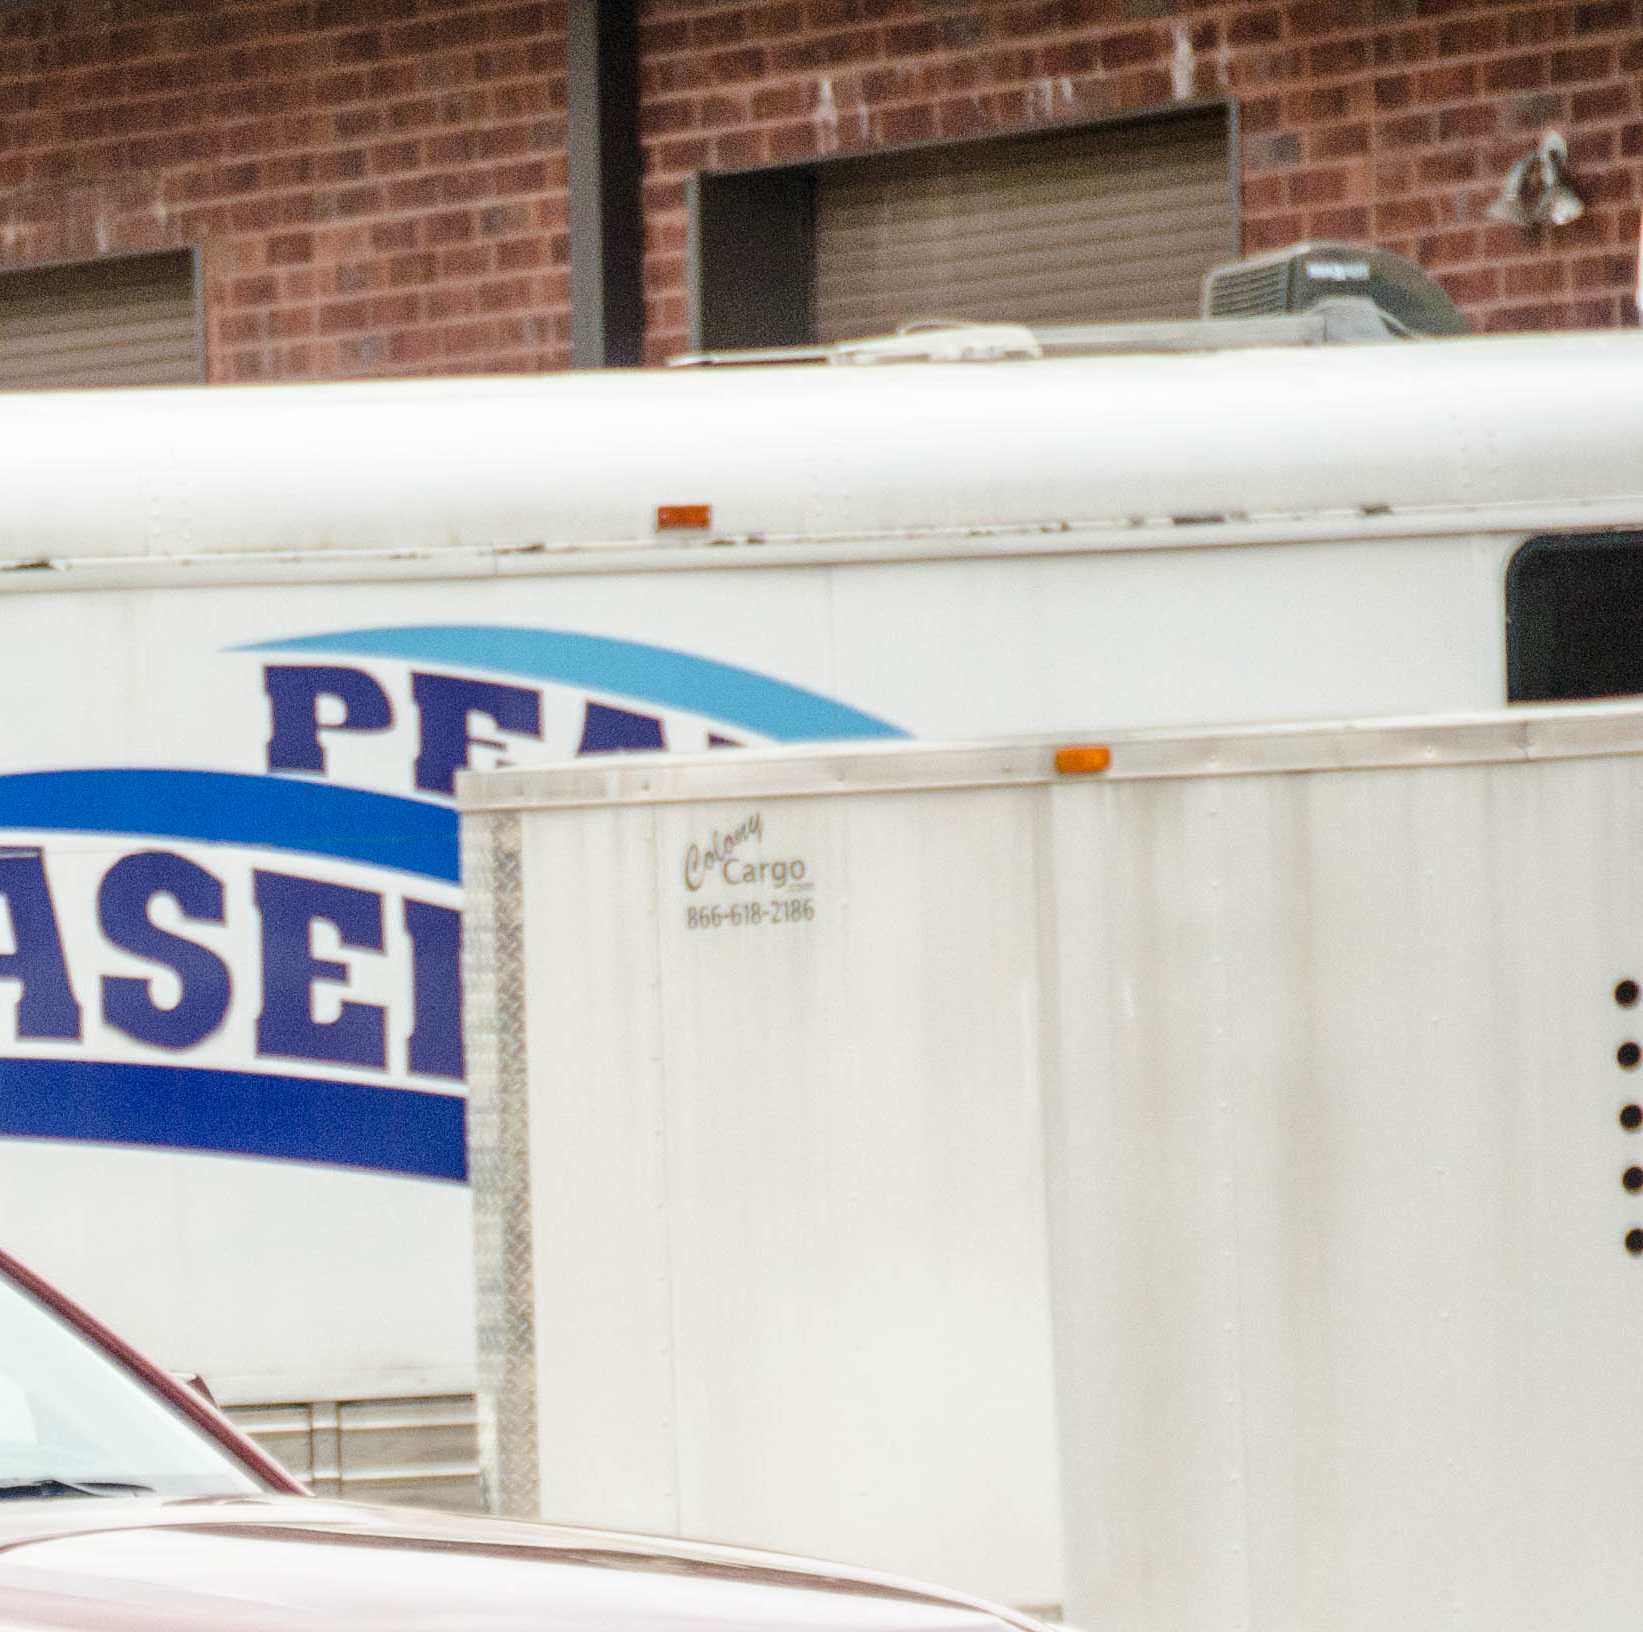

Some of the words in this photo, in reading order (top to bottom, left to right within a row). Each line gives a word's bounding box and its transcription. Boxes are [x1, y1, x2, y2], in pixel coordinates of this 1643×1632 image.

[263, 664, 747, 796] PE
[683, 811, 763, 892] Colony
[722, 857, 807, 889] Cargo
[687, 898, 815, 929] 866-618-2186
